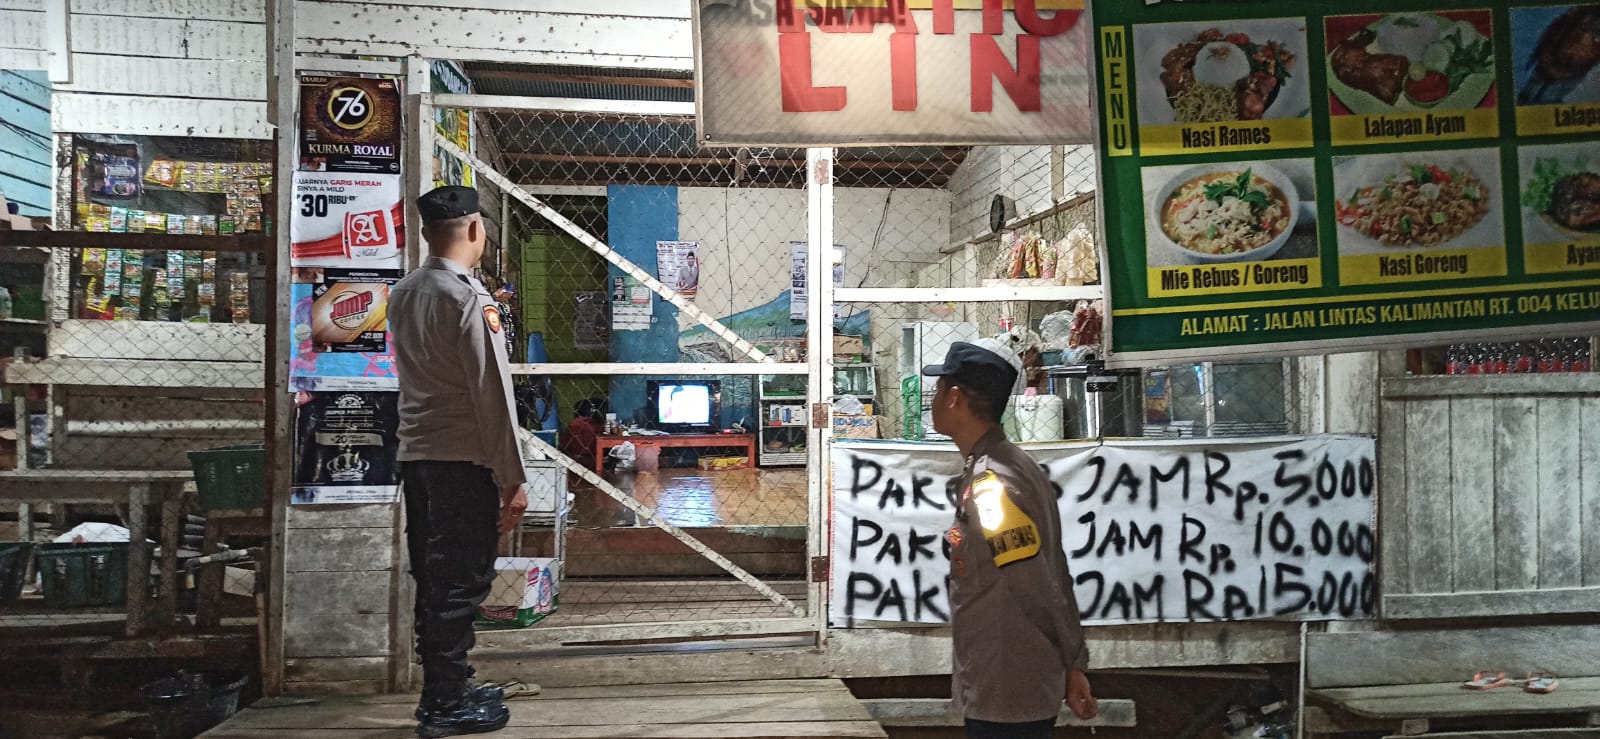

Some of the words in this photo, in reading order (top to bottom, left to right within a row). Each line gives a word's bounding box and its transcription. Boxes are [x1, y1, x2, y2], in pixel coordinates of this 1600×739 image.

[778, 31, 1041, 112] LIN
[333, 90, 367, 122] 76
[1104, 31, 1127, 150] MENU
[1182, 127, 1215, 148] Nasi
[1219, 126, 1271, 147] Rames
[1364, 116, 1422, 138] Lalapan
[1425, 114, 1465, 136] Ayam
[308, 144, 351, 154] KURMA
[353, 145, 394, 156] ROYAL
[301, 194, 328, 217] 30
[328, 195, 347, 205] RIBU
[1161, 269, 1189, 290] Mie
[1192, 266, 1240, 288] Rebus
[1253, 264, 1308, 284] Goreng
[1380, 256, 1412, 277] Nasi
[1415, 253, 1468, 275] Goreng
[1181, 315, 1249, 336] ALAMAT
[1263, 310, 1316, 331] JALAN
[1319, 306, 1376, 327] LINTAS
[1381, 300, 1485, 323] KALIMANTAN
[1489, 297, 1514, 316] RT.
[1517, 295, 1552, 313] 004
[1076, 456, 1190, 511] JAM
[1203, 450, 1270, 521] Rp.
[1273, 449, 1374, 507] 5.000
[1071, 511, 1163, 561] JAM
[1179, 513, 1236, 574] Rp.
[1253, 512, 1375, 564] 10.000
[1075, 570, 1165, 621] JAM
